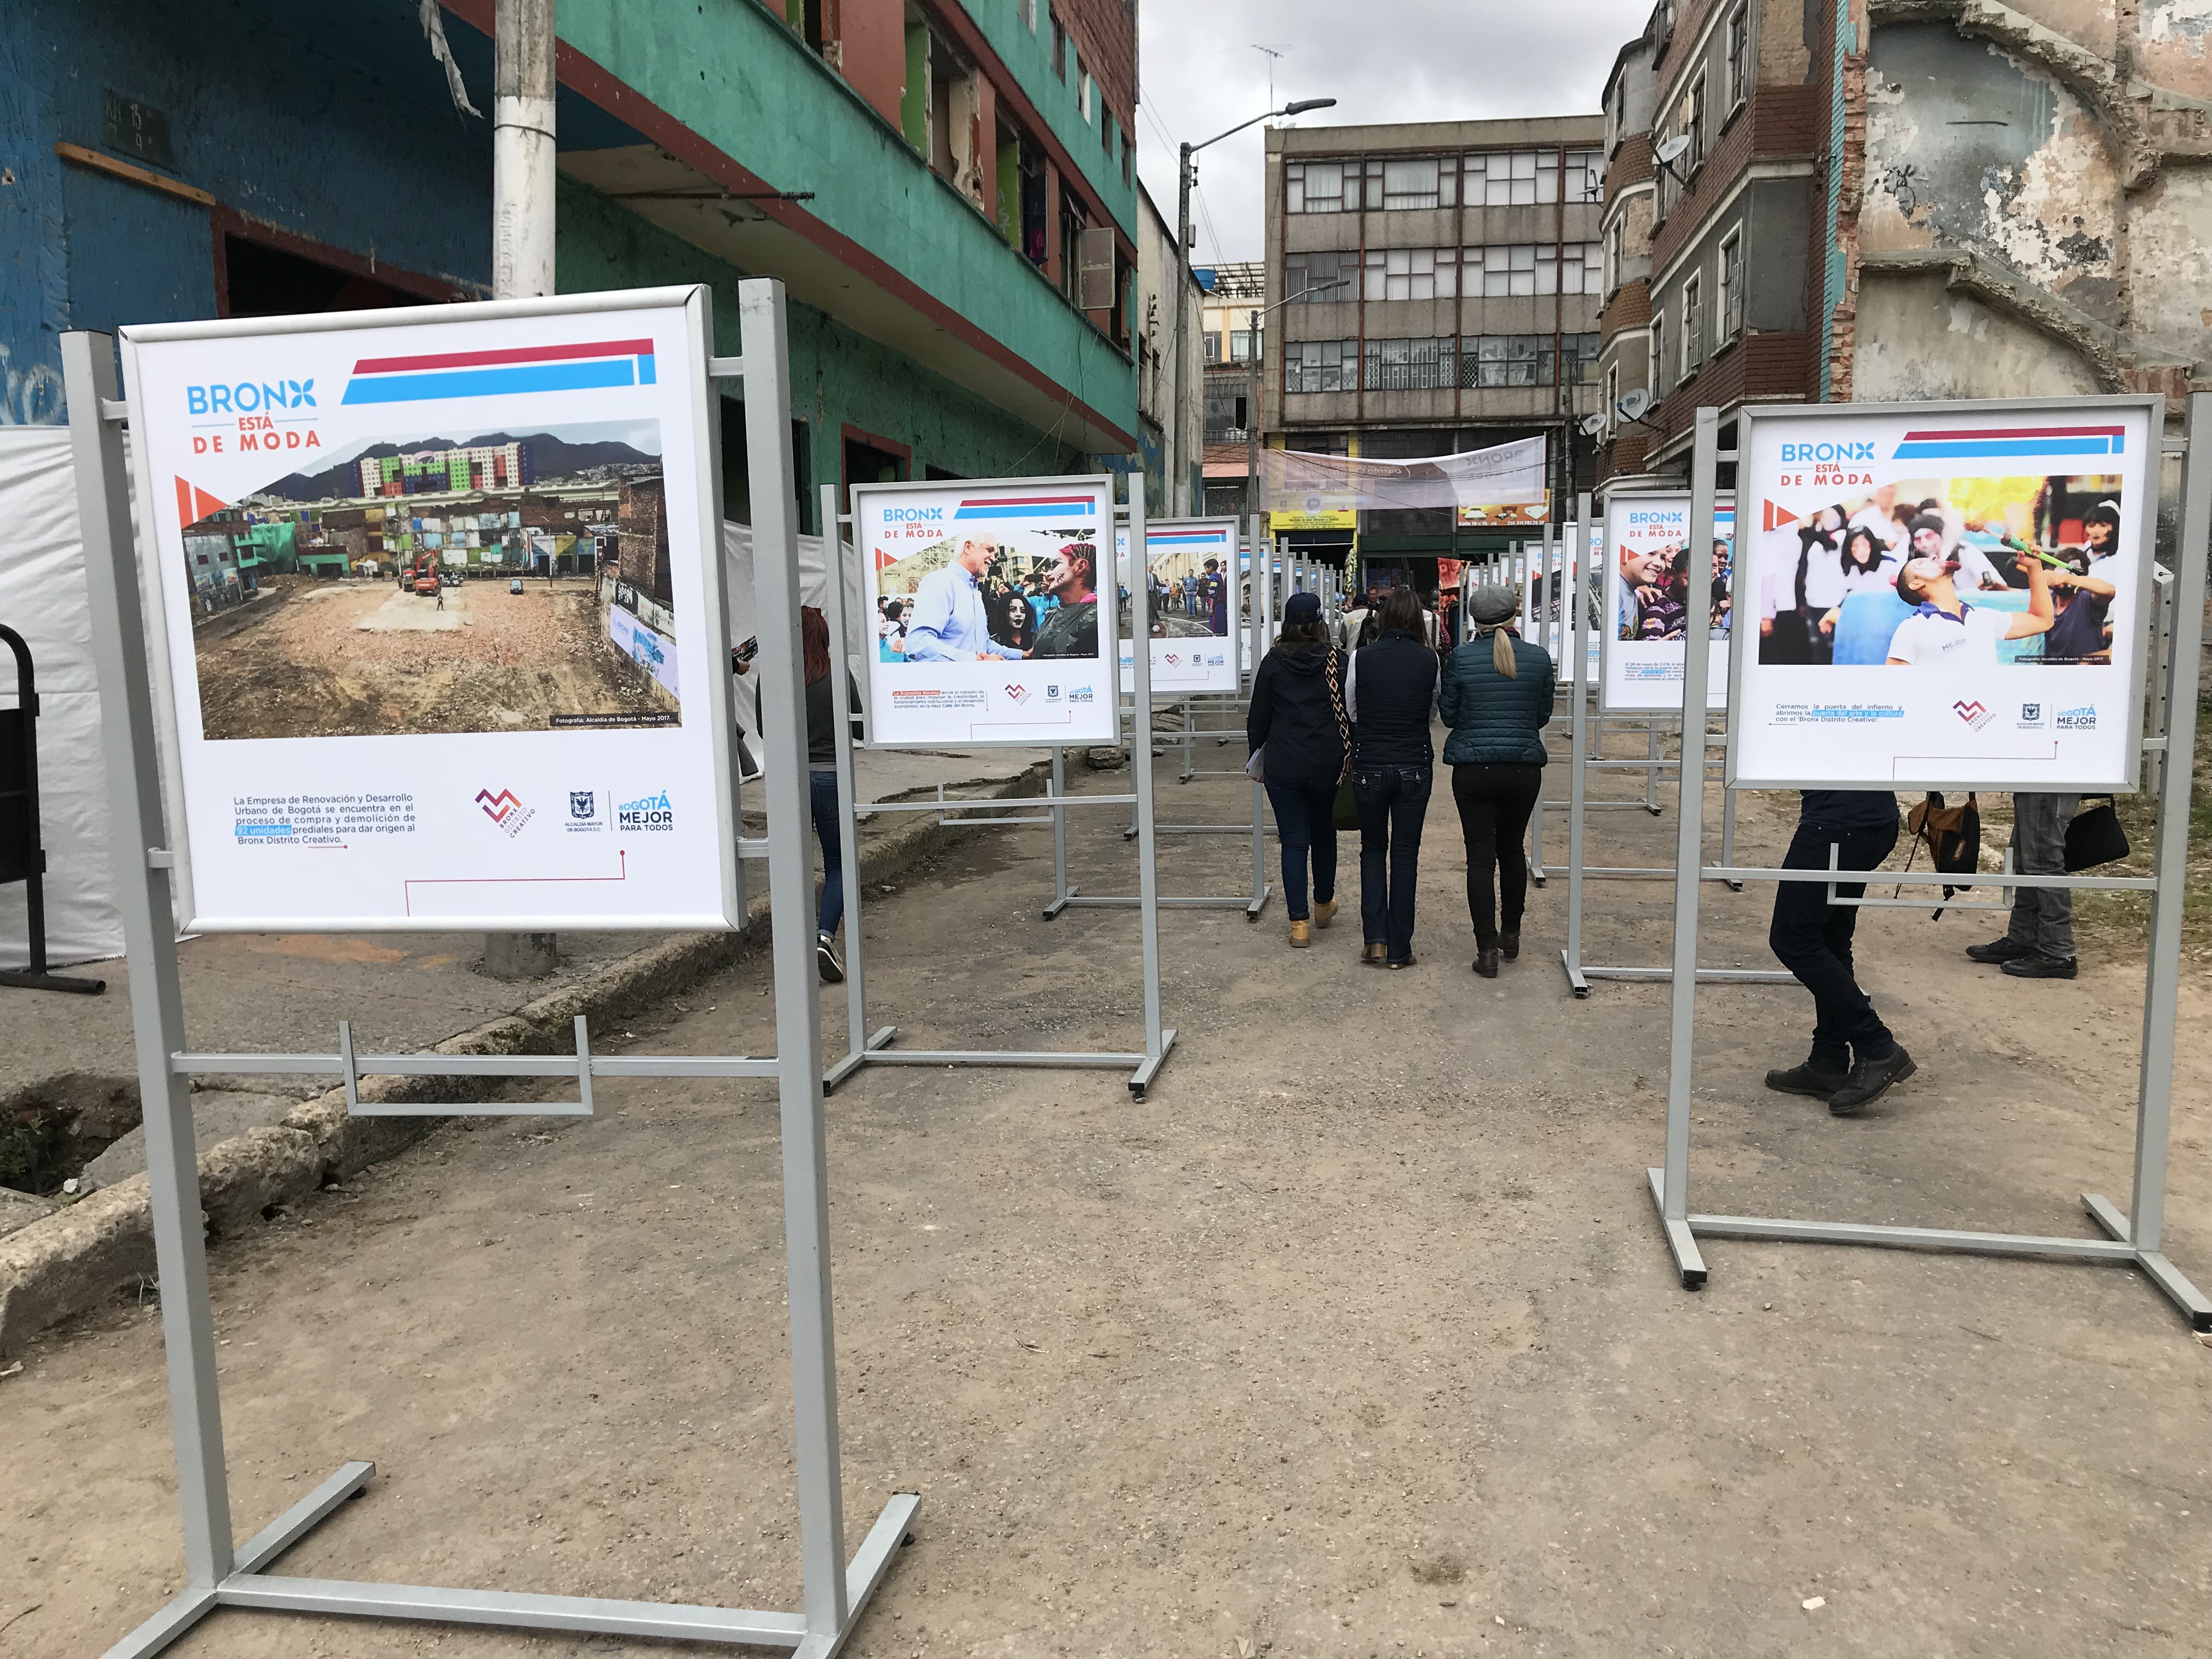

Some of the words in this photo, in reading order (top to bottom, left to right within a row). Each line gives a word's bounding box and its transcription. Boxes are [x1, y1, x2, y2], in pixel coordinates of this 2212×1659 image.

[187, 378, 317, 415] BRONX
[238, 411, 274, 431] ESTÁ
[193, 436, 223, 454] DE
[240, 430, 321, 451] MODA
[1781, 442, 1875, 461] BRONX
[1815, 461, 1841, 472] ESTÁ
[1781, 475, 1802, 486] DE
[1814, 473, 1872, 486] MODA
[884, 507, 943, 521] BRONX
[1629, 512, 1683, 523] BRONX
[906, 521, 922, 529] ESTÁ
[906, 529, 943, 538] MODA
[1942, 639, 1967, 651] MEJOR
[2057, 703, 2096, 716] BOGOTÁ
[234, 797, 245, 805] La
[247, 796, 286, 806] Empresa
[289, 795, 300, 804] de
[302, 794, 356, 804] Renovación
[366, 793, 413, 803] Desarrollo
[618, 789, 672, 811] BOGOTÁ
[235, 806, 268, 815] Urbano
[272, 806, 283, 815] de
[288, 805, 321, 815] Bogotá
[236, 817, 275, 826] proceso
[294, 816, 331, 825] compra
[344, 814, 400, 823] demolición
[499, 807, 518, 829] BRONX
[510, 808, 535, 838] CREATIVO
[619, 811, 673, 824] MEJOR
[236, 826, 247, 835] 92
[250, 826, 291, 834] unidades
[292, 825, 334, 835] prediales
[336, 826, 356, 834] para
[375, 824, 405, 834] origen
[407, 823, 415, 832] al
[238, 836, 264, 844] Bronx
[267, 836, 300, 844] Distrito
[302, 834, 343, 843] Creativo.
